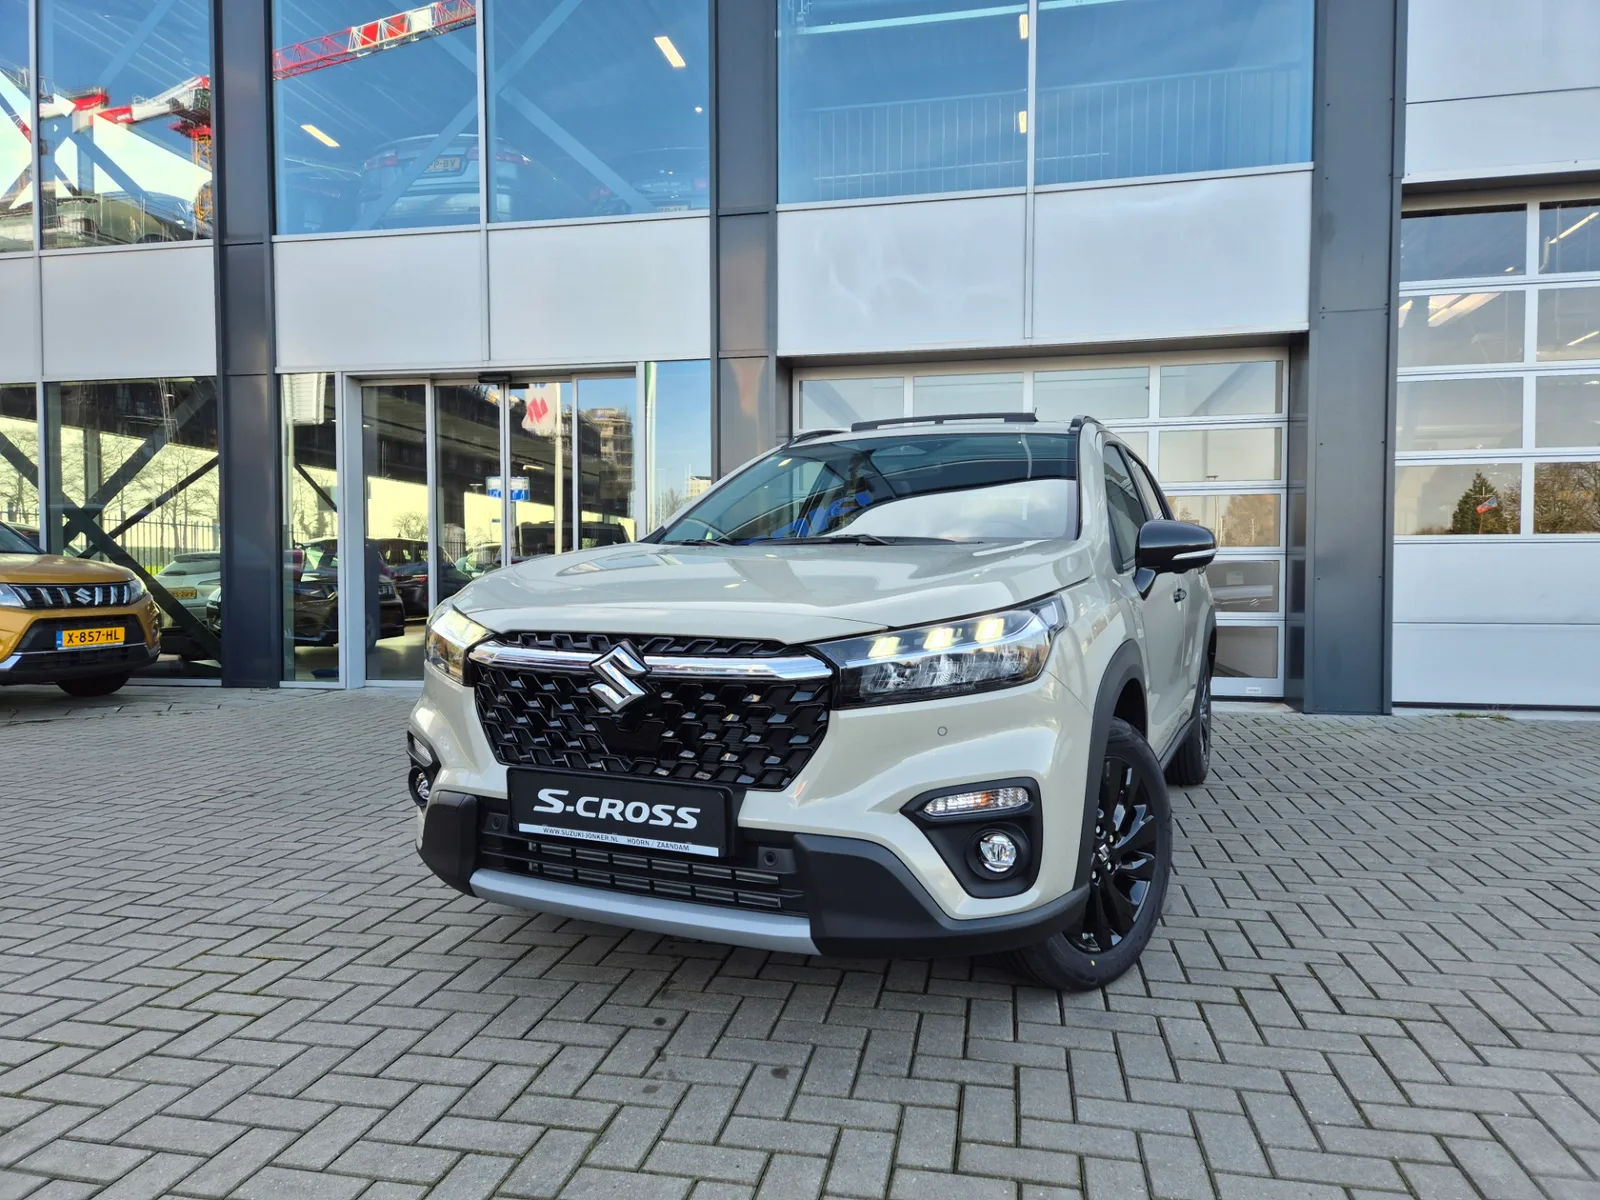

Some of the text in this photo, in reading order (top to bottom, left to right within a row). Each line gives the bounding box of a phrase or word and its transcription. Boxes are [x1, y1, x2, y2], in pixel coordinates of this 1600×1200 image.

[67, 629, 120, 644] X-857-HL
[533, 788, 700, 829] S-CROSS
[543, 827, 619, 842] WWW.SUZUKI-JONKER.NL
[627, 838, 650, 846] HOORN
[656, 841, 690, 851] ZAANDAM
